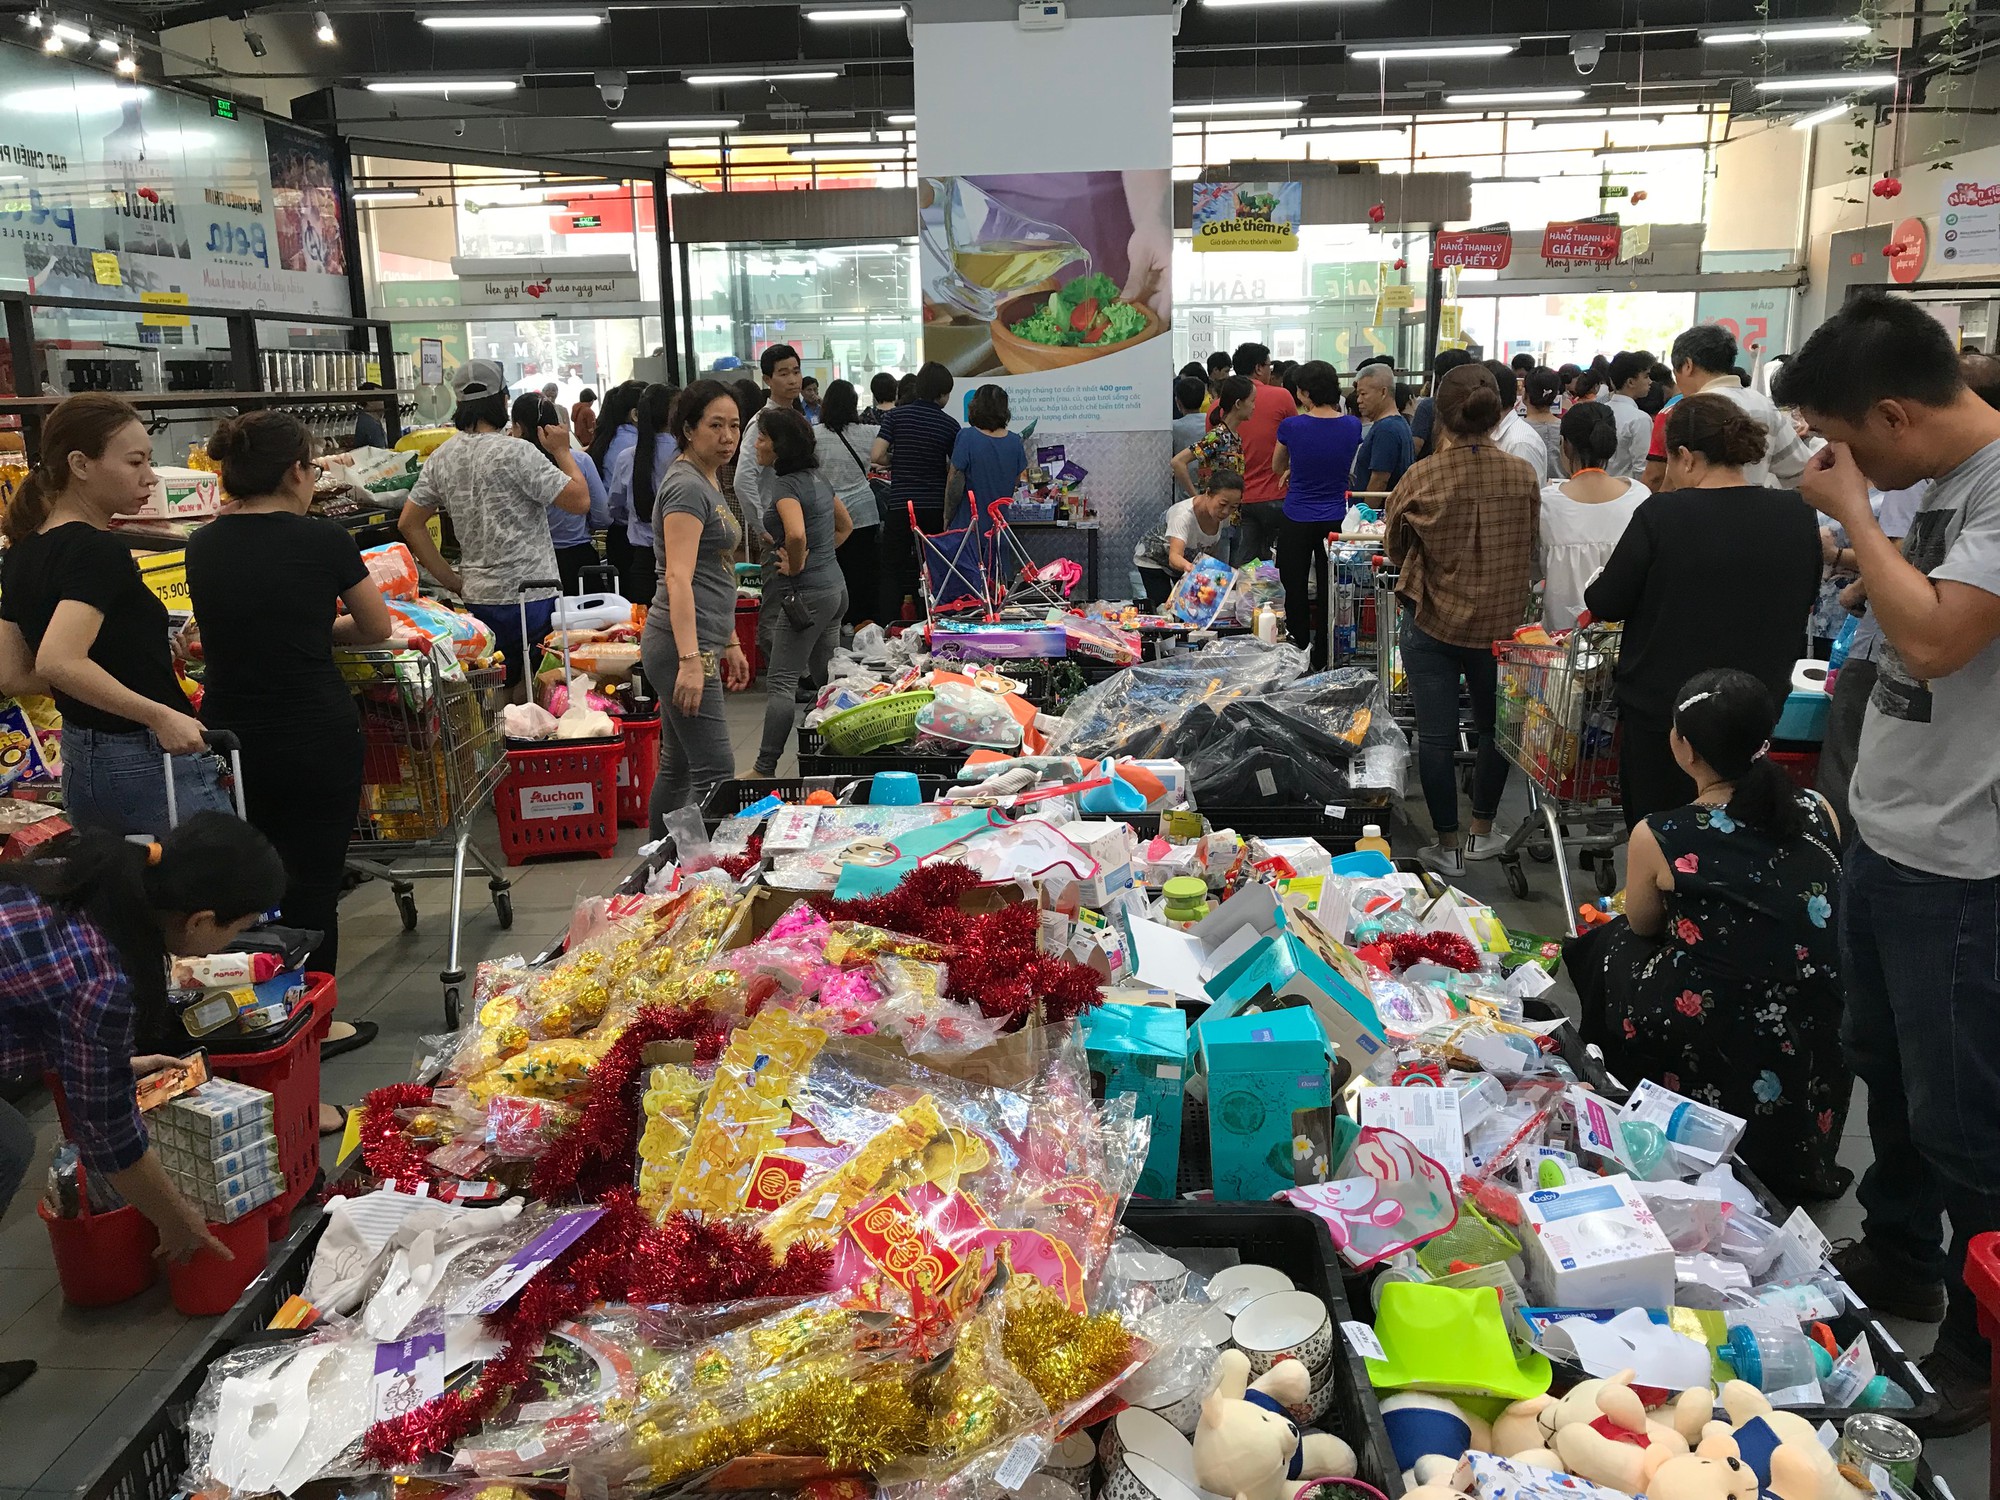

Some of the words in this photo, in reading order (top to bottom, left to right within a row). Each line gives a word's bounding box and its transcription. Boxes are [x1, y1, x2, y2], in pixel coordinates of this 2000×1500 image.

[1202, 223, 1219, 236] Có
[1243, 217, 1275, 233] thêm
[1277, 224, 1291, 236] rẻ
[1549, 231, 1573, 241] HÀNG
[1573, 233, 1601, 243] THANH
[1440, 240, 1463, 251] HÀNG
[1464, 244, 1492, 253] THANH
[1492, 243, 1503, 253] LÝ
[1552, 242, 1573, 254] GIÁ
[1573, 242, 1595, 255] HẾT
[1443, 251, 1465, 265] GIÁ
[1465, 252, 1487, 266] HẾT
[1489, 253, 1498, 266] Ý
[1099, 384, 1114, 392] 400
[1114, 385, 1133, 394] gram
[530, 791, 584, 803] Auchan
[1533, 1192, 1557, 1203] baby
